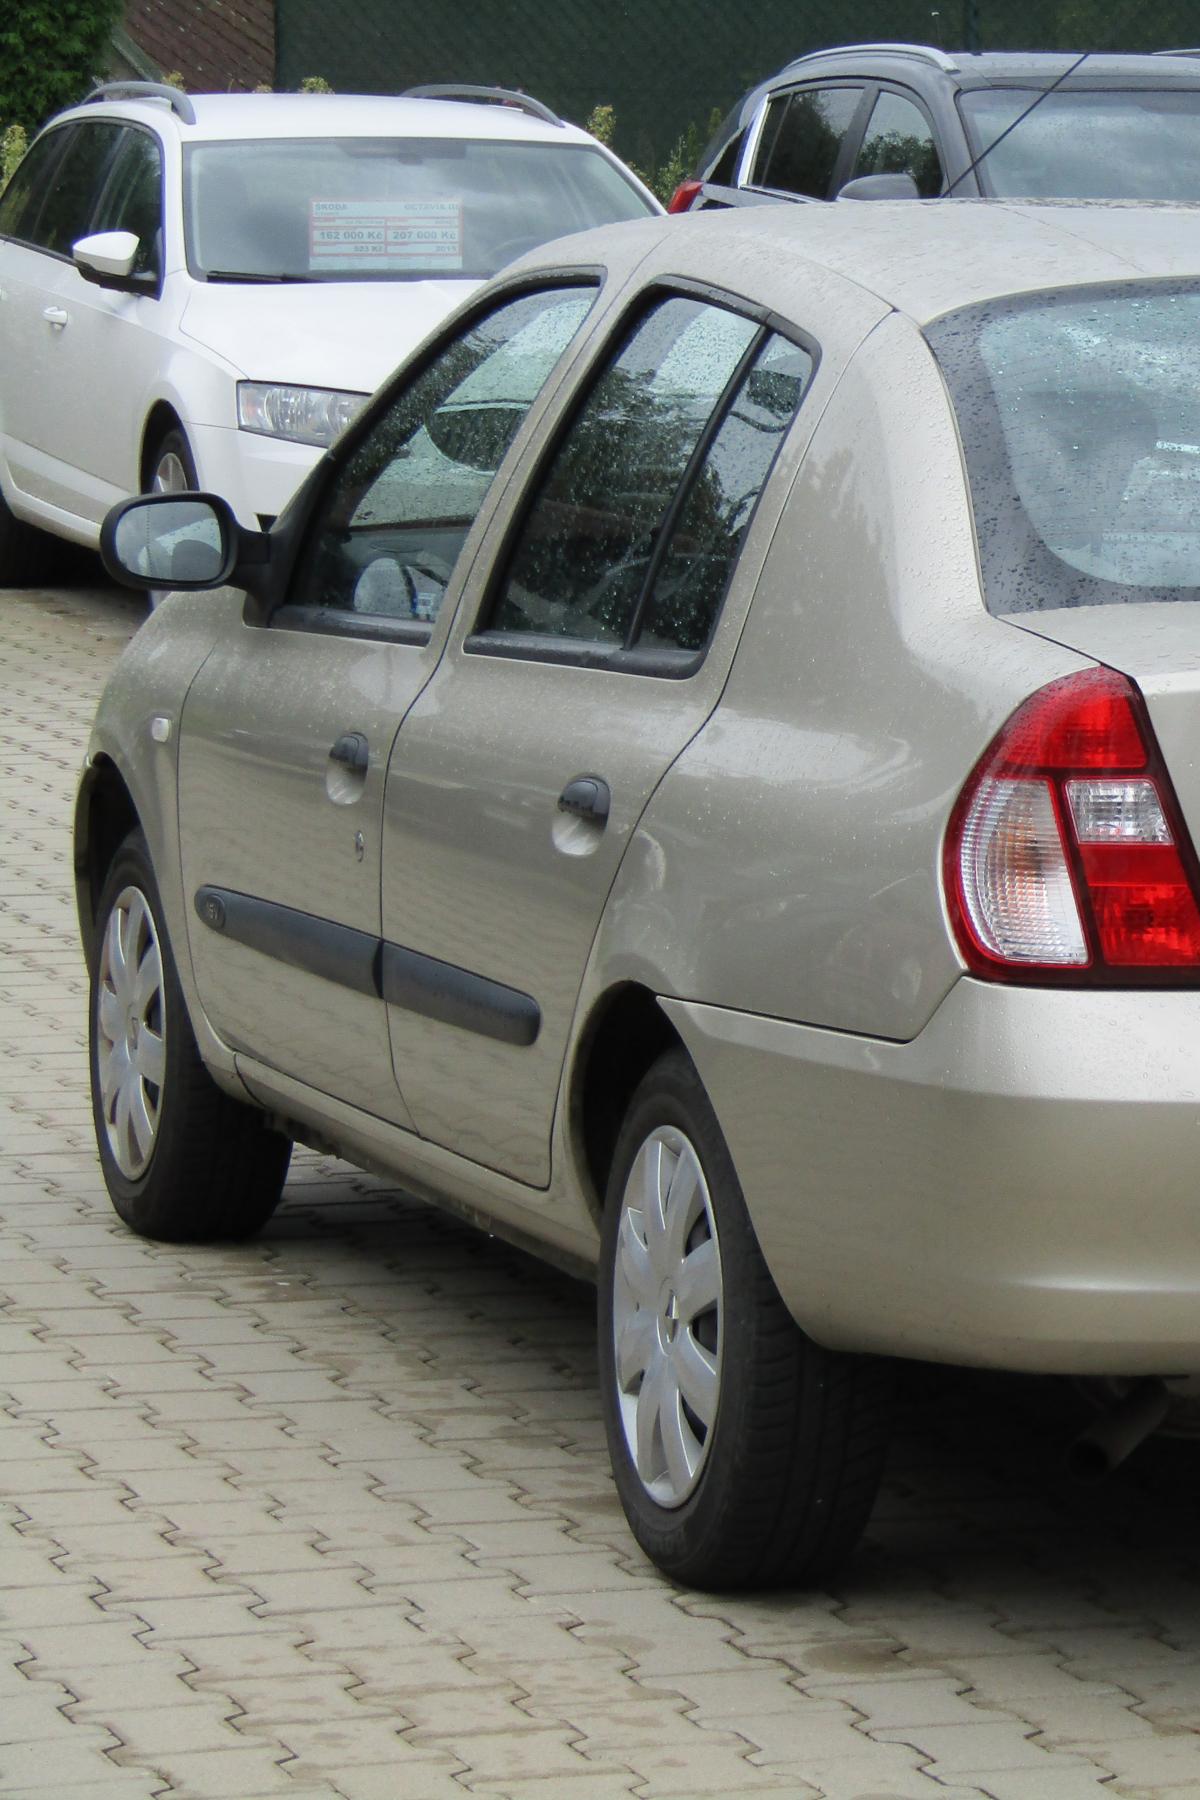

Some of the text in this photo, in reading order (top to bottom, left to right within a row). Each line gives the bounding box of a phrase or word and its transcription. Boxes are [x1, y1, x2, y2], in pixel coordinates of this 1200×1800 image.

[320, 231, 340, 240] 162
[343, 231, 364, 240] 000
[392, 231, 413, 240] 207
[416, 231, 437, 240] 000
